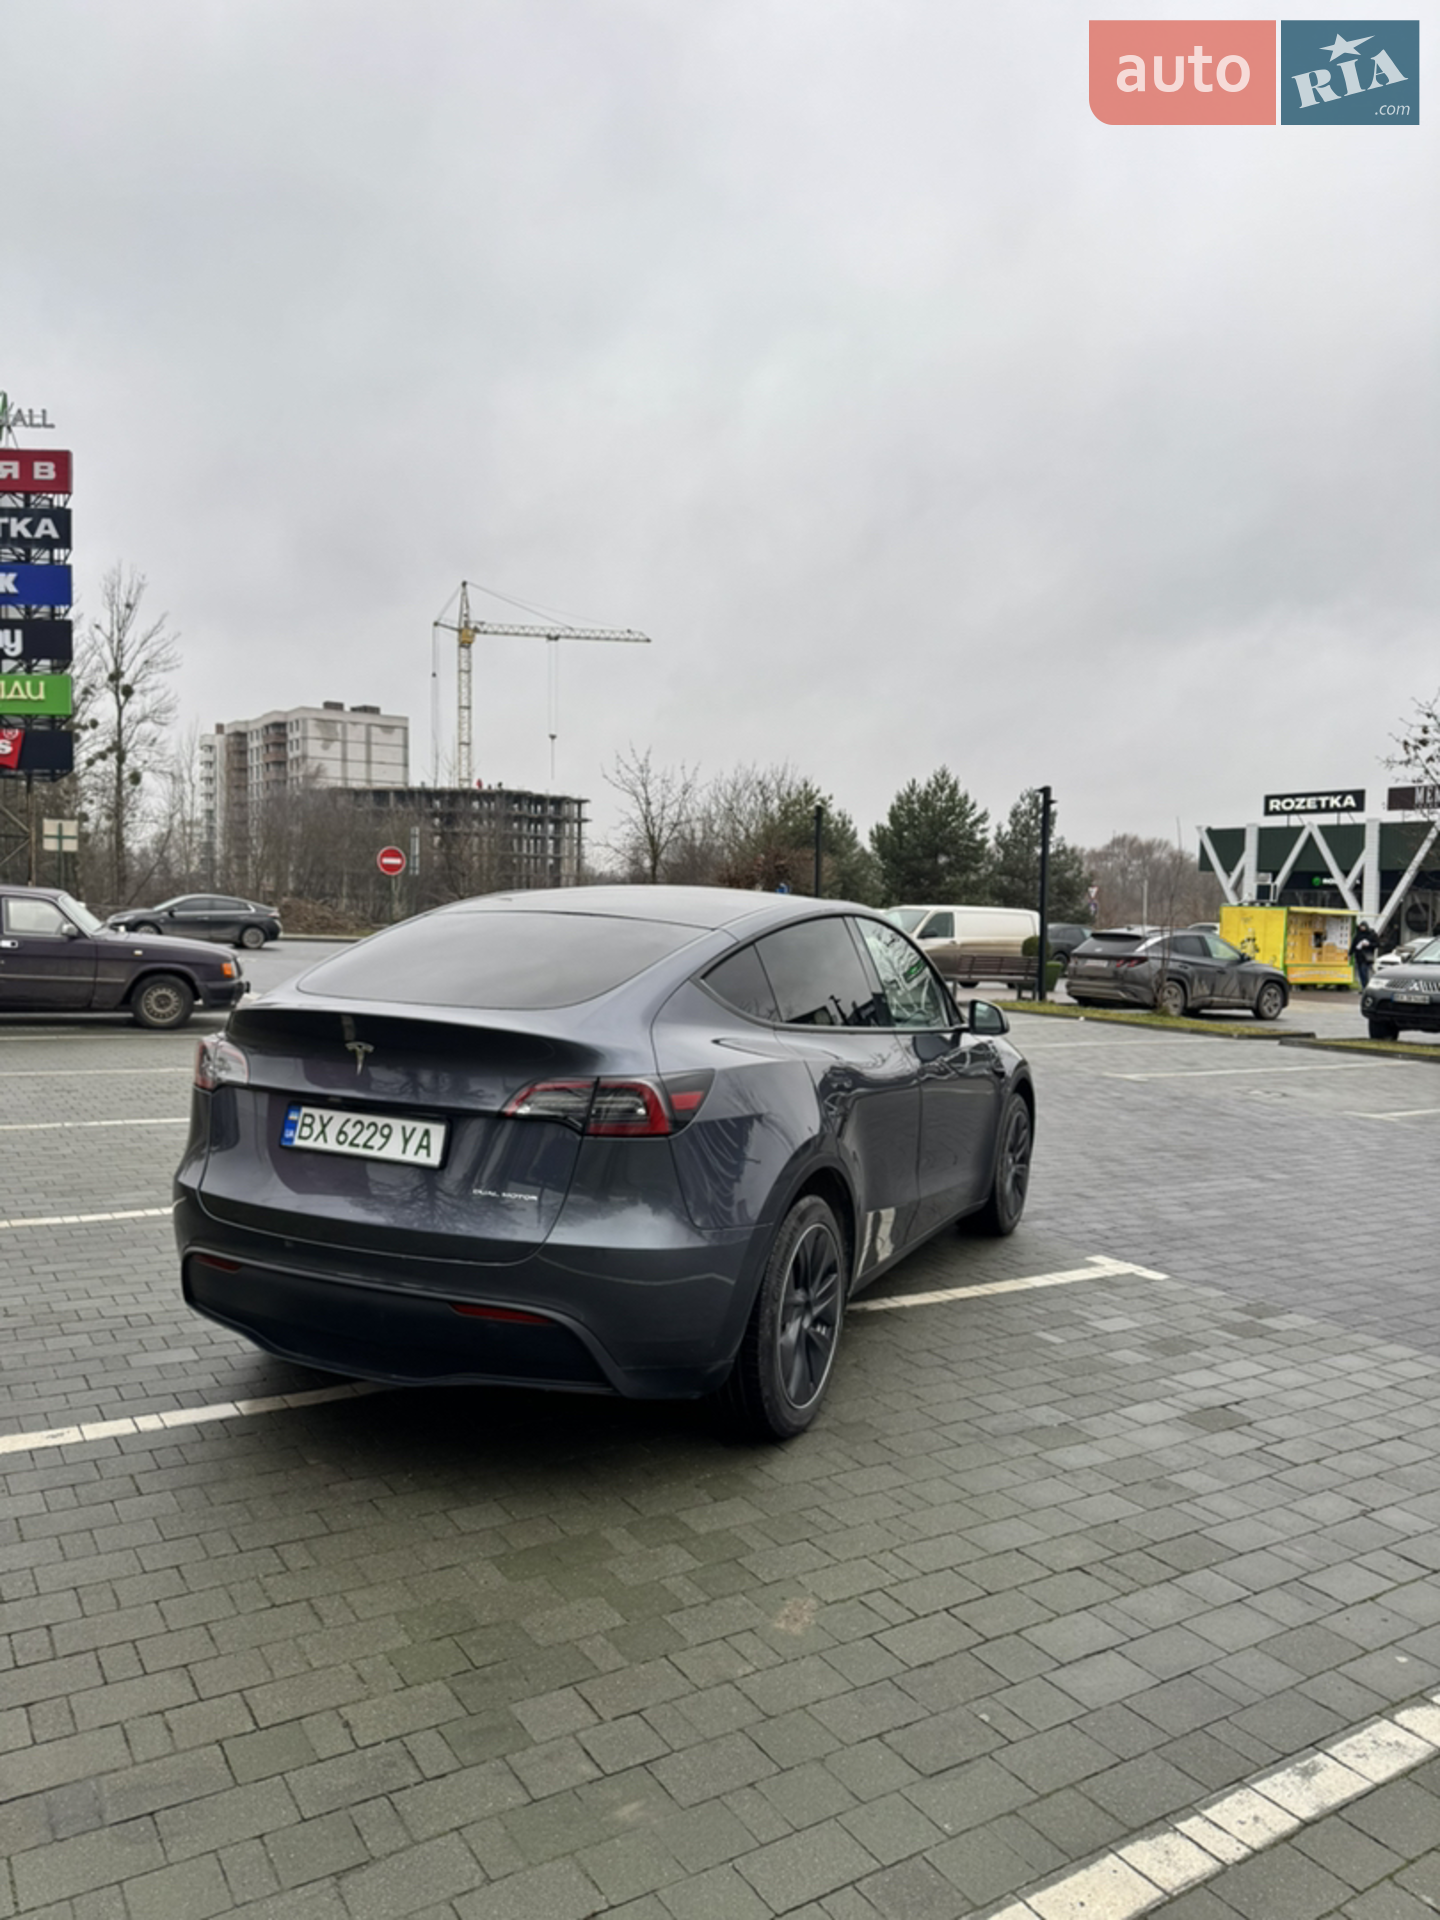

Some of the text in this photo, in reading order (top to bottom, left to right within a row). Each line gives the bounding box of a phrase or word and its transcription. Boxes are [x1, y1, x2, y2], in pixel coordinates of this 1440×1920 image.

[1268, 794, 1357, 812] ROZETKA
[298, 1112, 434, 1159] BX 6229 YA
